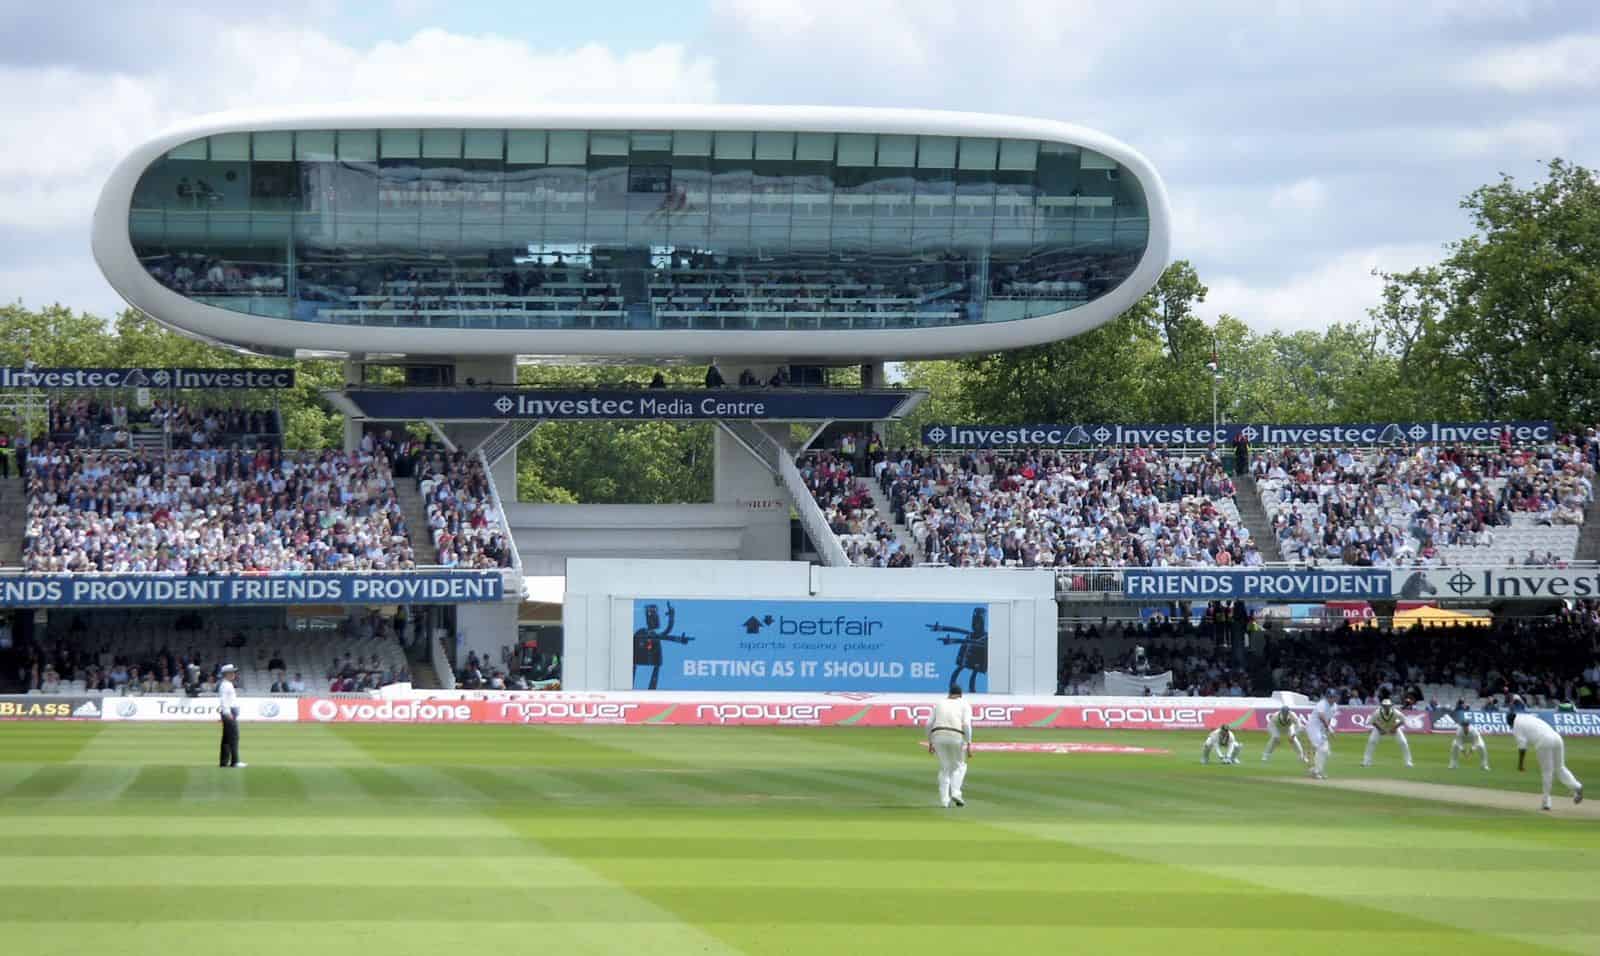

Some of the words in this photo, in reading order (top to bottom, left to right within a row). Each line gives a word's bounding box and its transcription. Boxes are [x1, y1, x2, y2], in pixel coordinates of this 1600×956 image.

[175, 369, 289, 387] Investec
[518, 395, 634, 414] Investec
[640, 398, 693, 415] Media
[701, 398, 765, 415] Centre
[951, 426, 1062, 444] Investec
[1116, 425, 1227, 444] Investec
[1262, 425, 1377, 442] Investec
[1432, 423, 1549, 441] Investec
[73, 580, 225, 600] PROVIDENT
[231, 579, 342, 599] FRIENDS
[353, 578, 499, 598] PROVIDENT
[1127, 575, 1233, 594] FRIENDS
[1244, 575, 1389, 594] PROVIDENT
[779, 616, 883, 636] betfair
[683, 659, 766, 677] BETTING
[772, 660, 795, 678] AS
[800, 660, 816, 678] IT
[823, 661, 904, 679] SHOULD
[910, 663, 940, 680] BE.
[0, 702, 72, 717] BLASS
[342, 702, 471, 720] vodafone
[501, 702, 639, 722] npower
[696, 703, 832, 722] npower
[891, 705, 1025, 725] nper
[1082, 707, 1215, 727] npower
